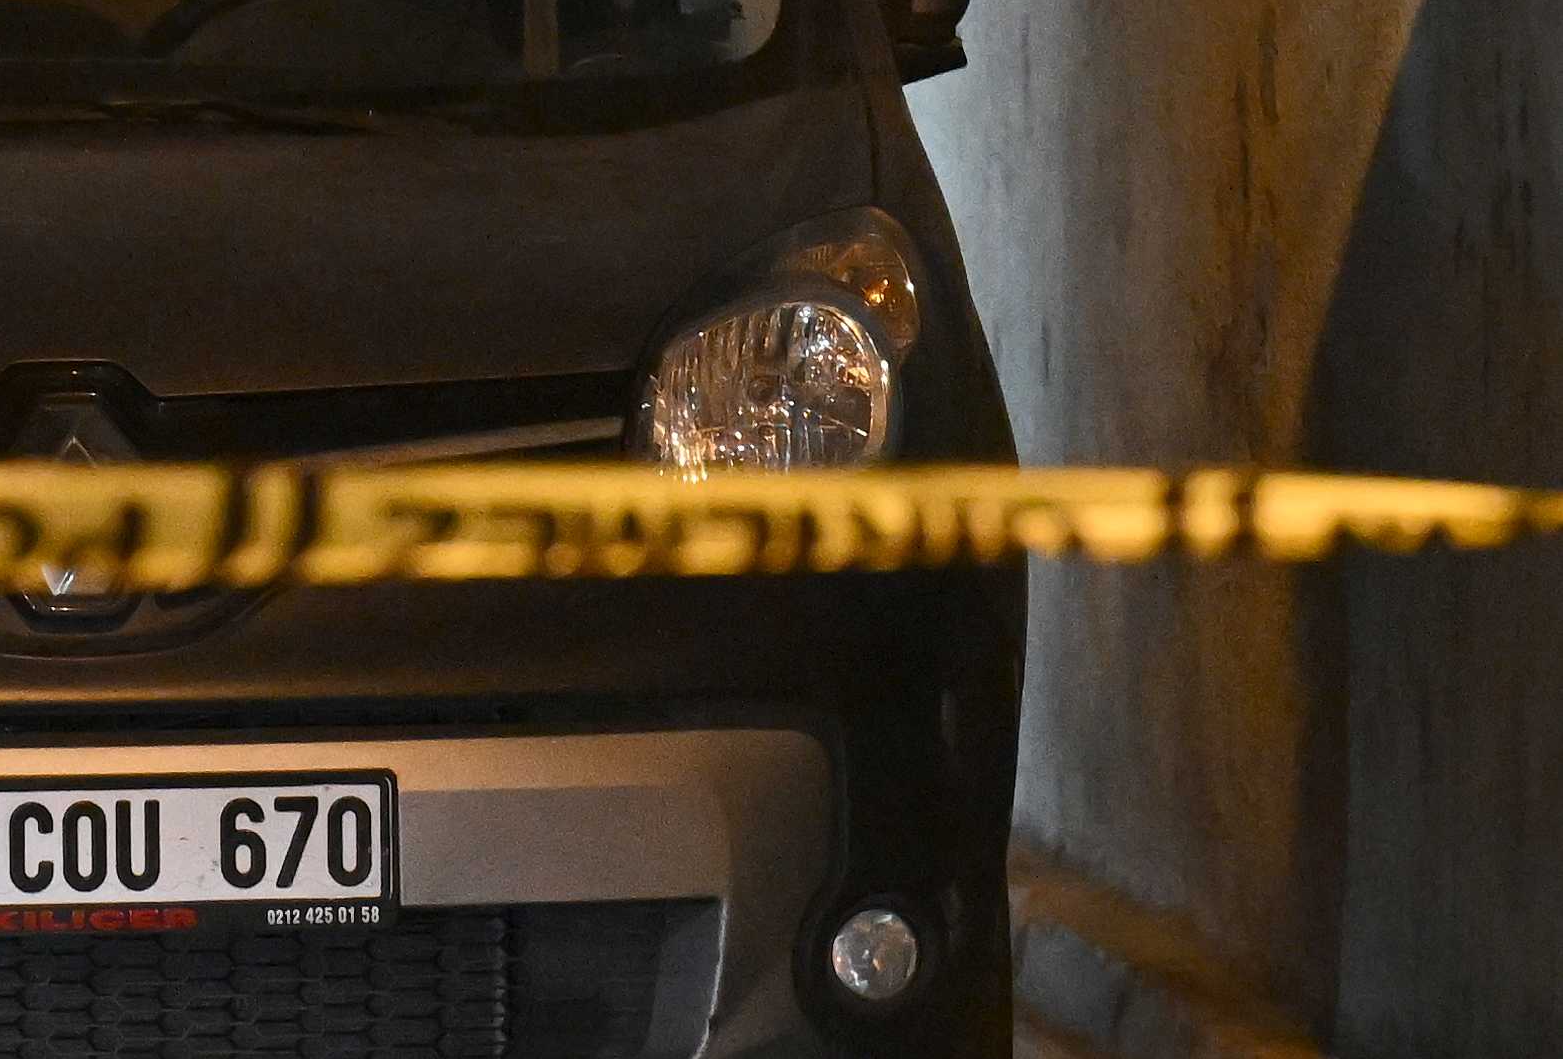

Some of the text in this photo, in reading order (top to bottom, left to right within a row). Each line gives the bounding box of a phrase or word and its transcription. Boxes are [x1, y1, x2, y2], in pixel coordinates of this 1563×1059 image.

[9, 798, 161, 894] COU
[218, 794, 373, 890] 670
[267, 905, 380, 926] 0212 425 01 58
